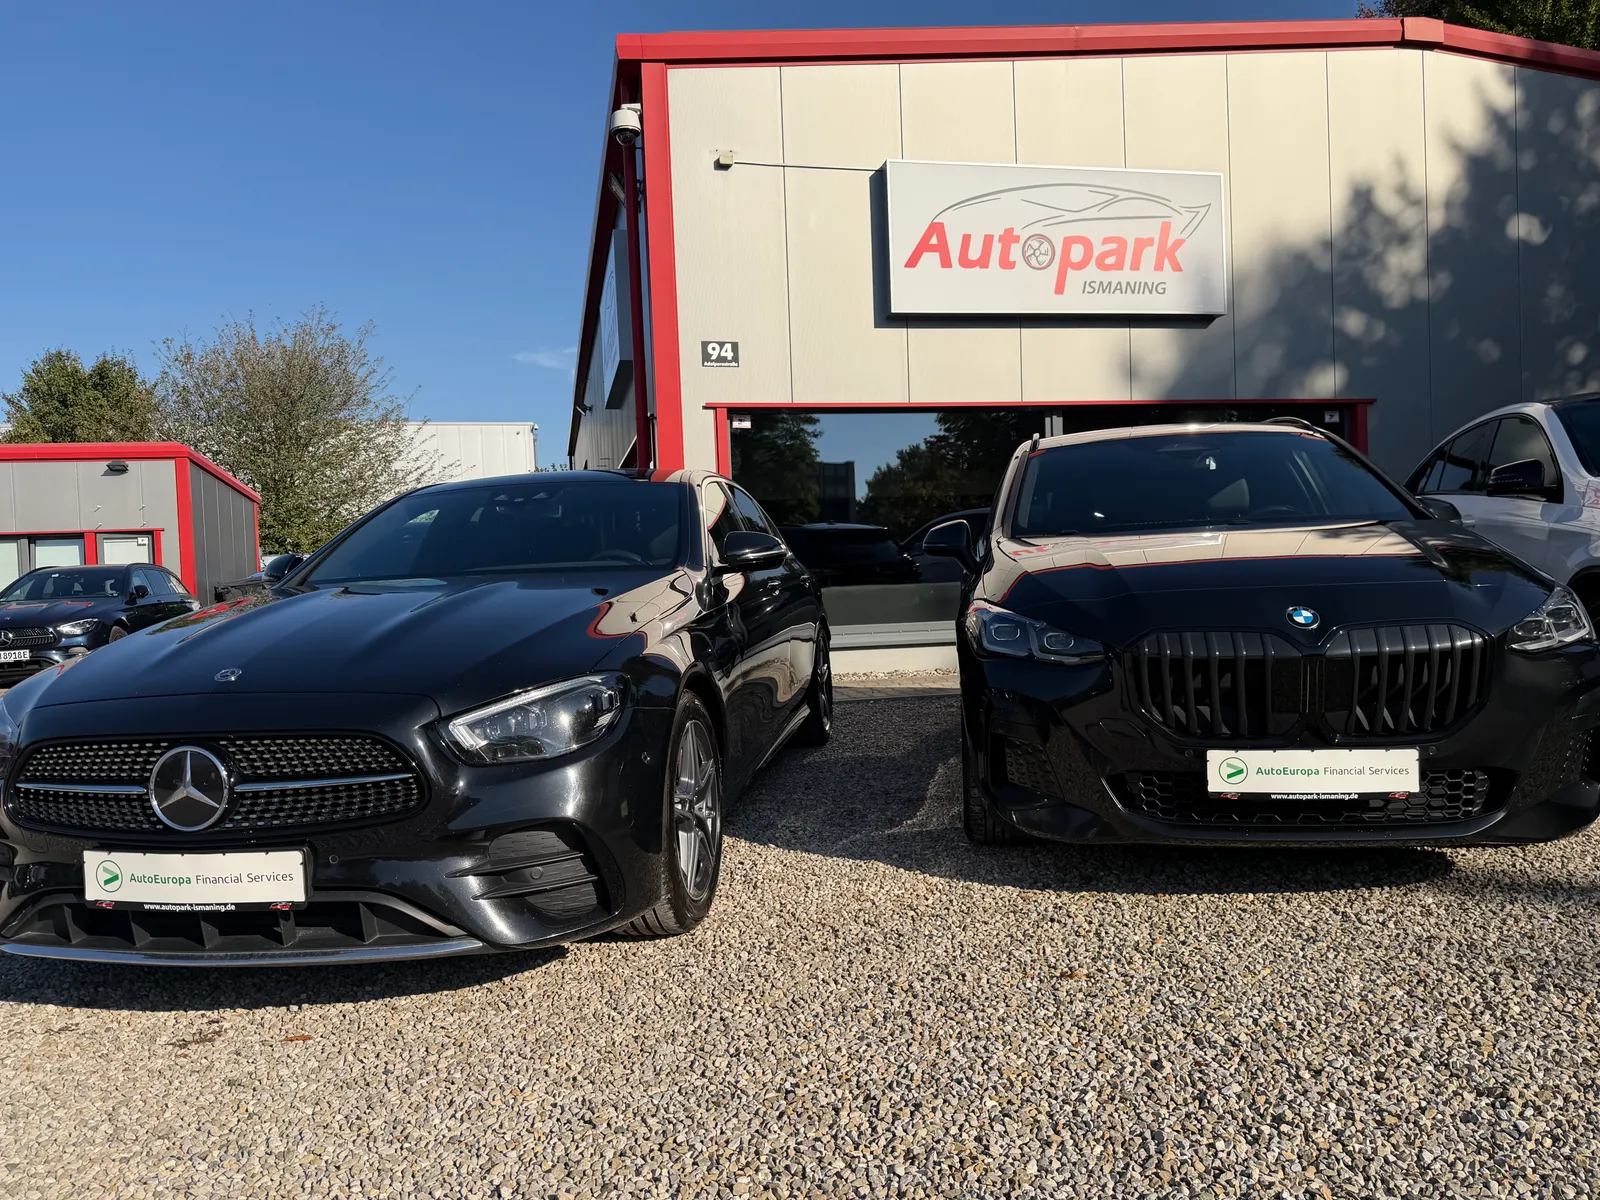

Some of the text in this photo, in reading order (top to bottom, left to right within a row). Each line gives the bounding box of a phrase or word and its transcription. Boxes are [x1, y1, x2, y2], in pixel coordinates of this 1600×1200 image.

[904, 220, 1185, 295] Autopark
[1081, 280, 1168, 296] ISMANING
[707, 342, 734, 360] 94
[1255, 766, 1410, 777] AutoEuropa Financial Services
[129, 871, 294, 886] AutoEuropa Financial Services
[144, 903, 236, 912] www.autopark-ismaning.de
